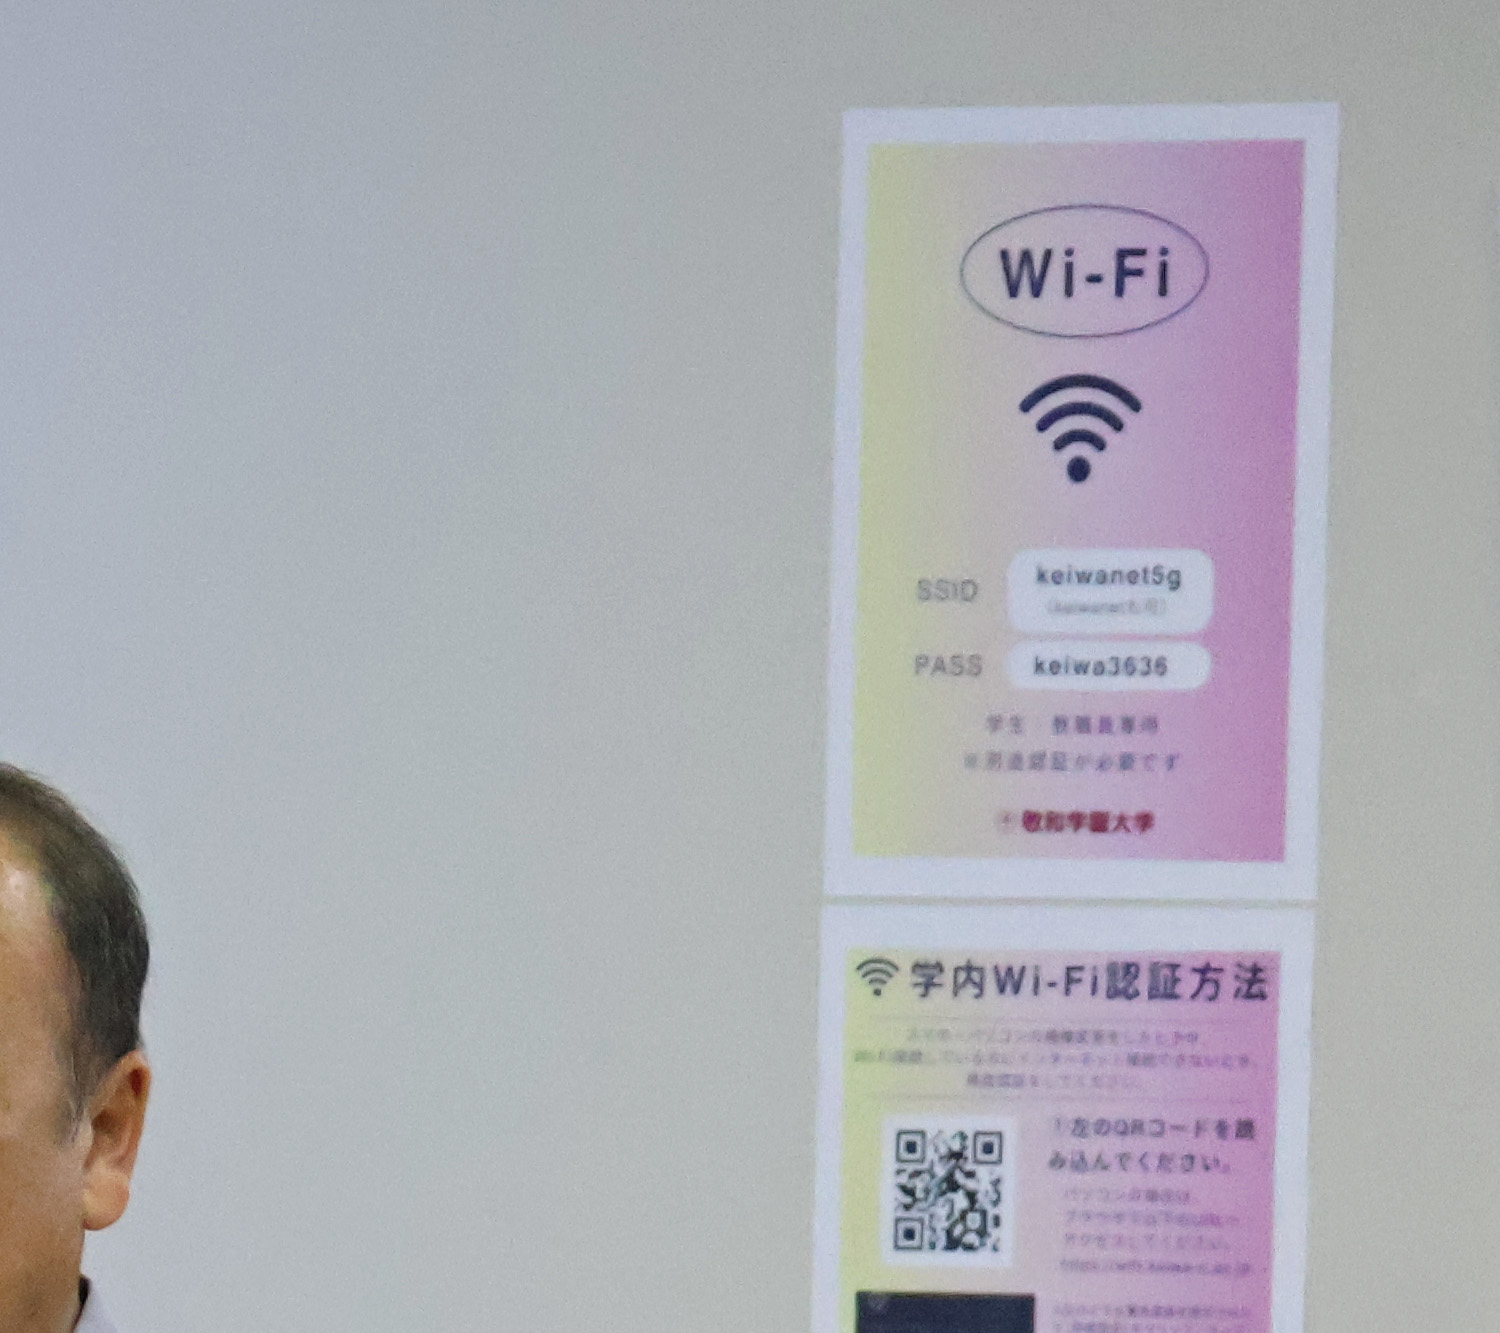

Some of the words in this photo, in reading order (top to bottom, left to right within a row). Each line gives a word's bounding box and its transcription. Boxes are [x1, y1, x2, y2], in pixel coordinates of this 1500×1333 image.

[1000, 247, 1170, 298] Wi-Fi
[916, 577, 979, 602] SSID
[1035, 564, 1183, 592] keiwanet5g
[914, 653, 983, 677] PASS
[1033, 655, 1169, 677] keiwa3636
[911, 960, 1268, 1001] 学内Wi-Fi認証方法
